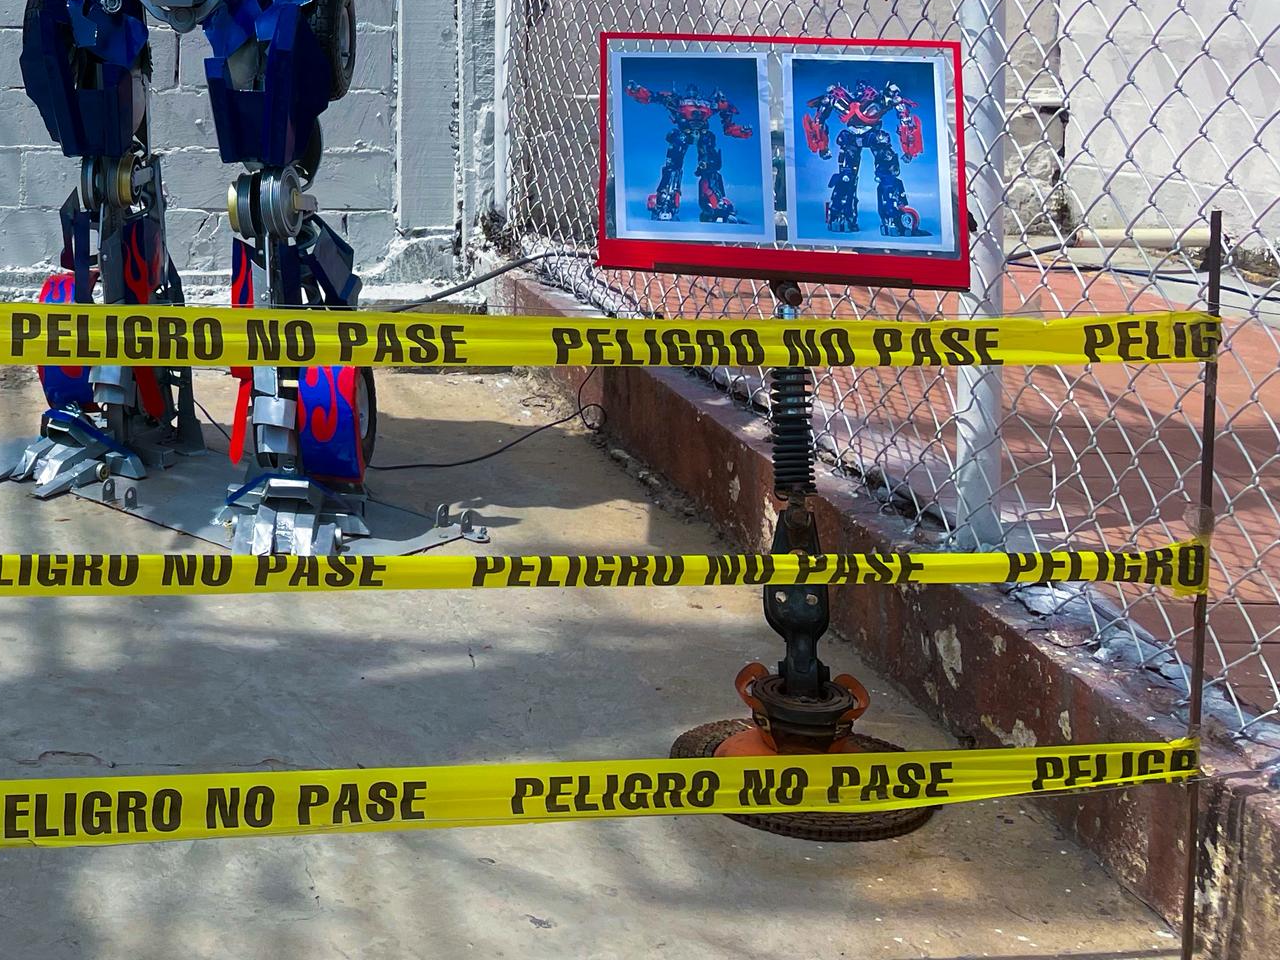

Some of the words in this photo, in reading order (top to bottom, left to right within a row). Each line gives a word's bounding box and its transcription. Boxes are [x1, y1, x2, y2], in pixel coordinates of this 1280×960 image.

[11, 312, 224, 361] PELIGRO
[246, 319, 317, 362] NO
[337, 321, 468, 365] PASE
[552, 327, 765, 366] PELIGRO
[782, 327, 856, 367] NO
[873, 327, 1004, 367] PASE
[161, 554, 231, 586] NO
[254, 555, 386, 587] PASE
[472, 555, 685, 587] PELIGRO
[705, 554, 775, 586] NO
[795, 553, 924, 584] PASE
[1005, 545, 1205, 587] PELIGRO
[206, 786, 276, 831] NO
[298, 780, 428, 826] PASE
[510, 770, 720, 815] PELIGRO
[738, 767, 809, 807] NO
[825, 761, 954, 804] PASE
